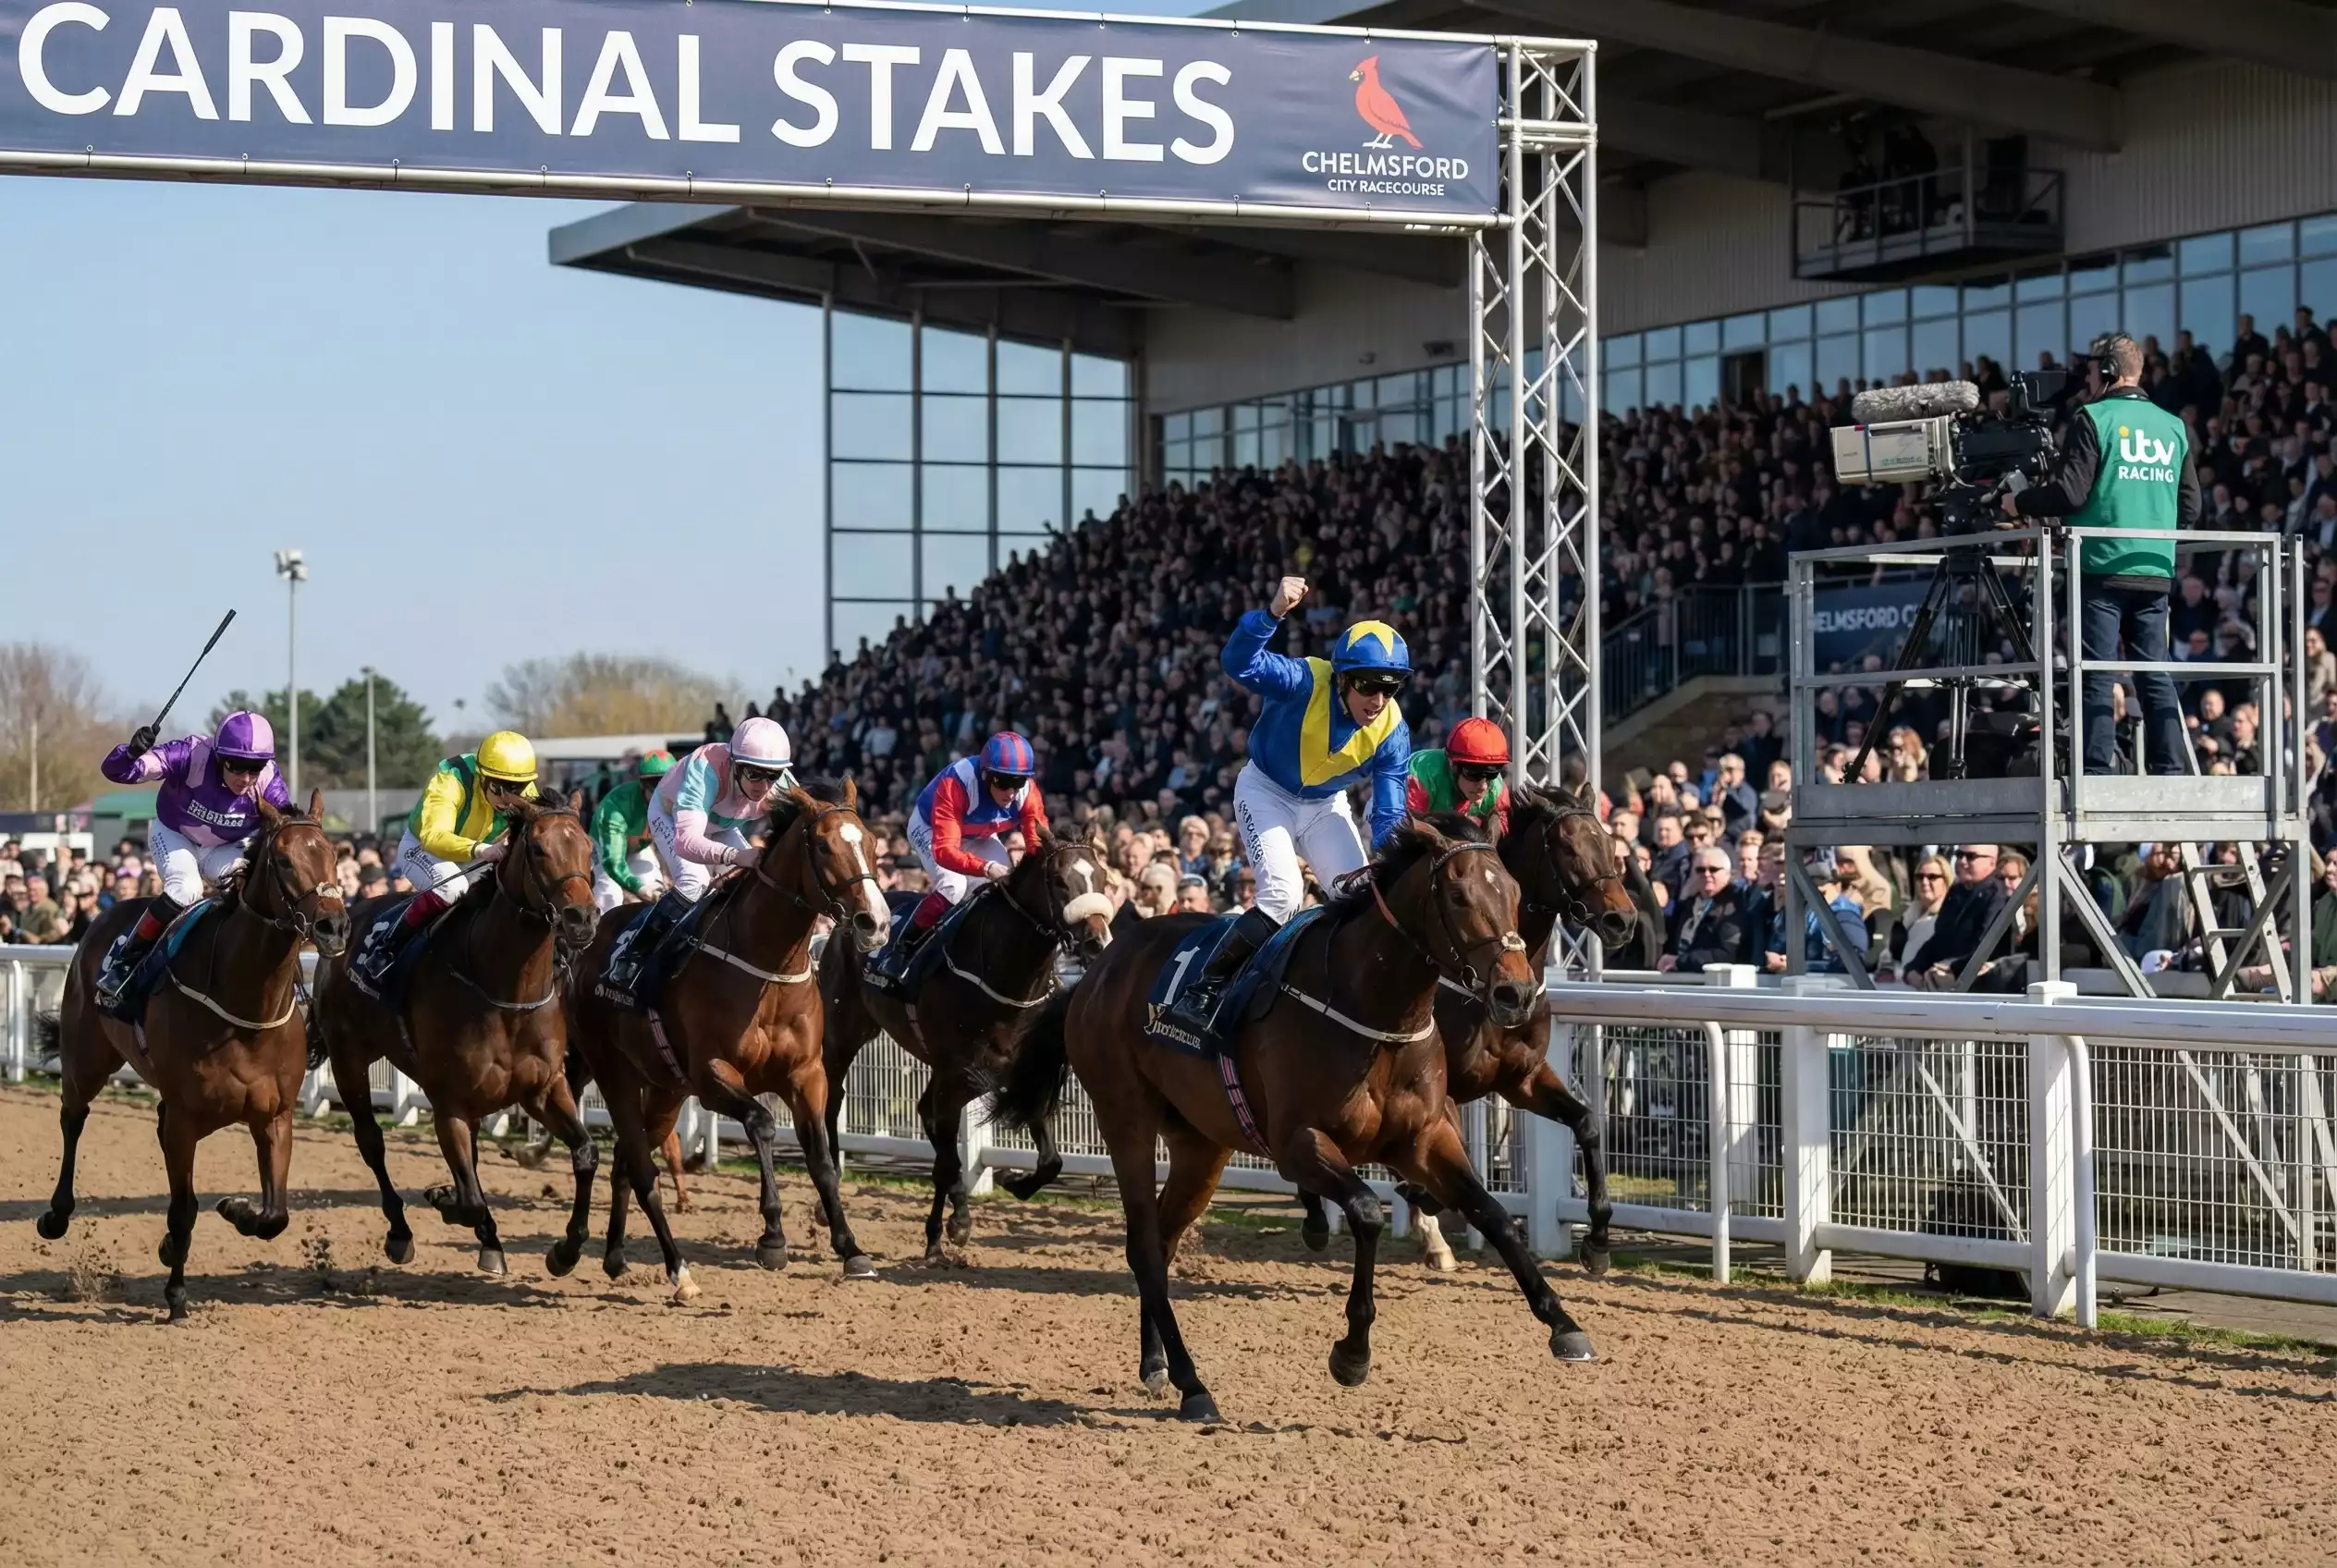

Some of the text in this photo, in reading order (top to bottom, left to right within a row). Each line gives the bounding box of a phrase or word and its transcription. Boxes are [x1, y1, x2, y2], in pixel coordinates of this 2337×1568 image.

[18, 2, 1235, 165] CARDINAL STAKES
[1302, 151, 1469, 180] CHELMSFORD
[1328, 178, 1445, 196] CITY RACECOURSE
[2119, 425, 2175, 466] itv
[2119, 465, 2174, 483] RACING
[1813, 606, 1900, 632] ELMSFORD
[1165, 946, 1200, 1005] 1
